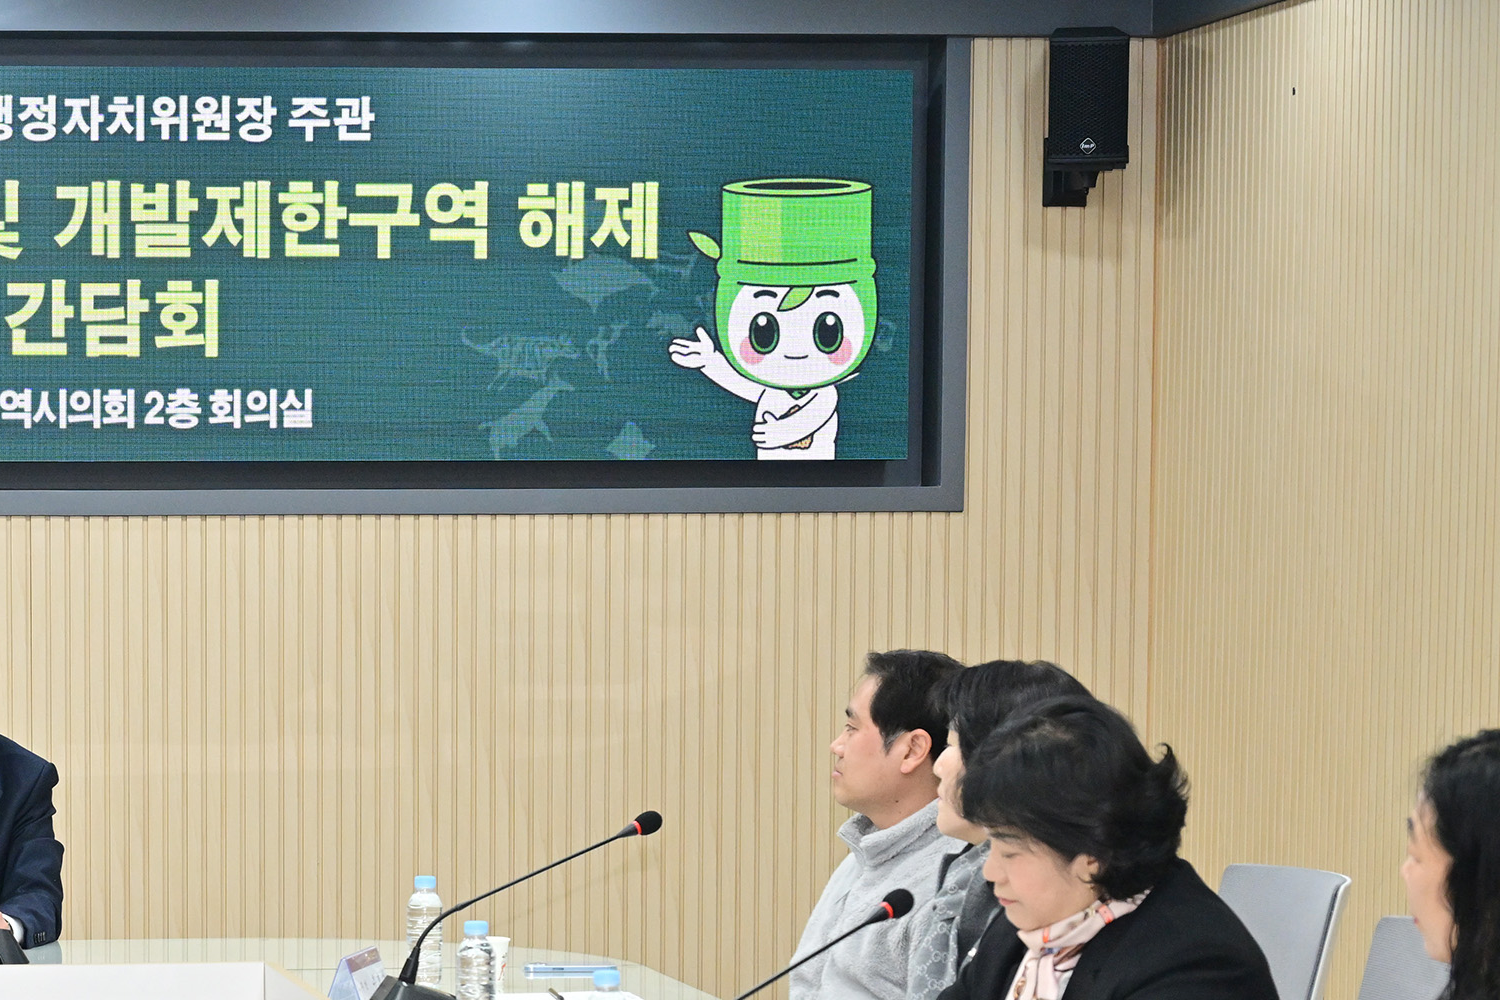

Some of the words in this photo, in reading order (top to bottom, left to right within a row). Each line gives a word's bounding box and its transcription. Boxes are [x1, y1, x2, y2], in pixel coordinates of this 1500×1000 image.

[288, 95, 375, 143] 주관
[53, 180, 489, 261] 개발제한구역
[517, 181, 659, 261] 해제
[4, 279, 219, 359] 간담회
[144, 388, 202, 429] 2층
[208, 388, 313, 429] 회의실
